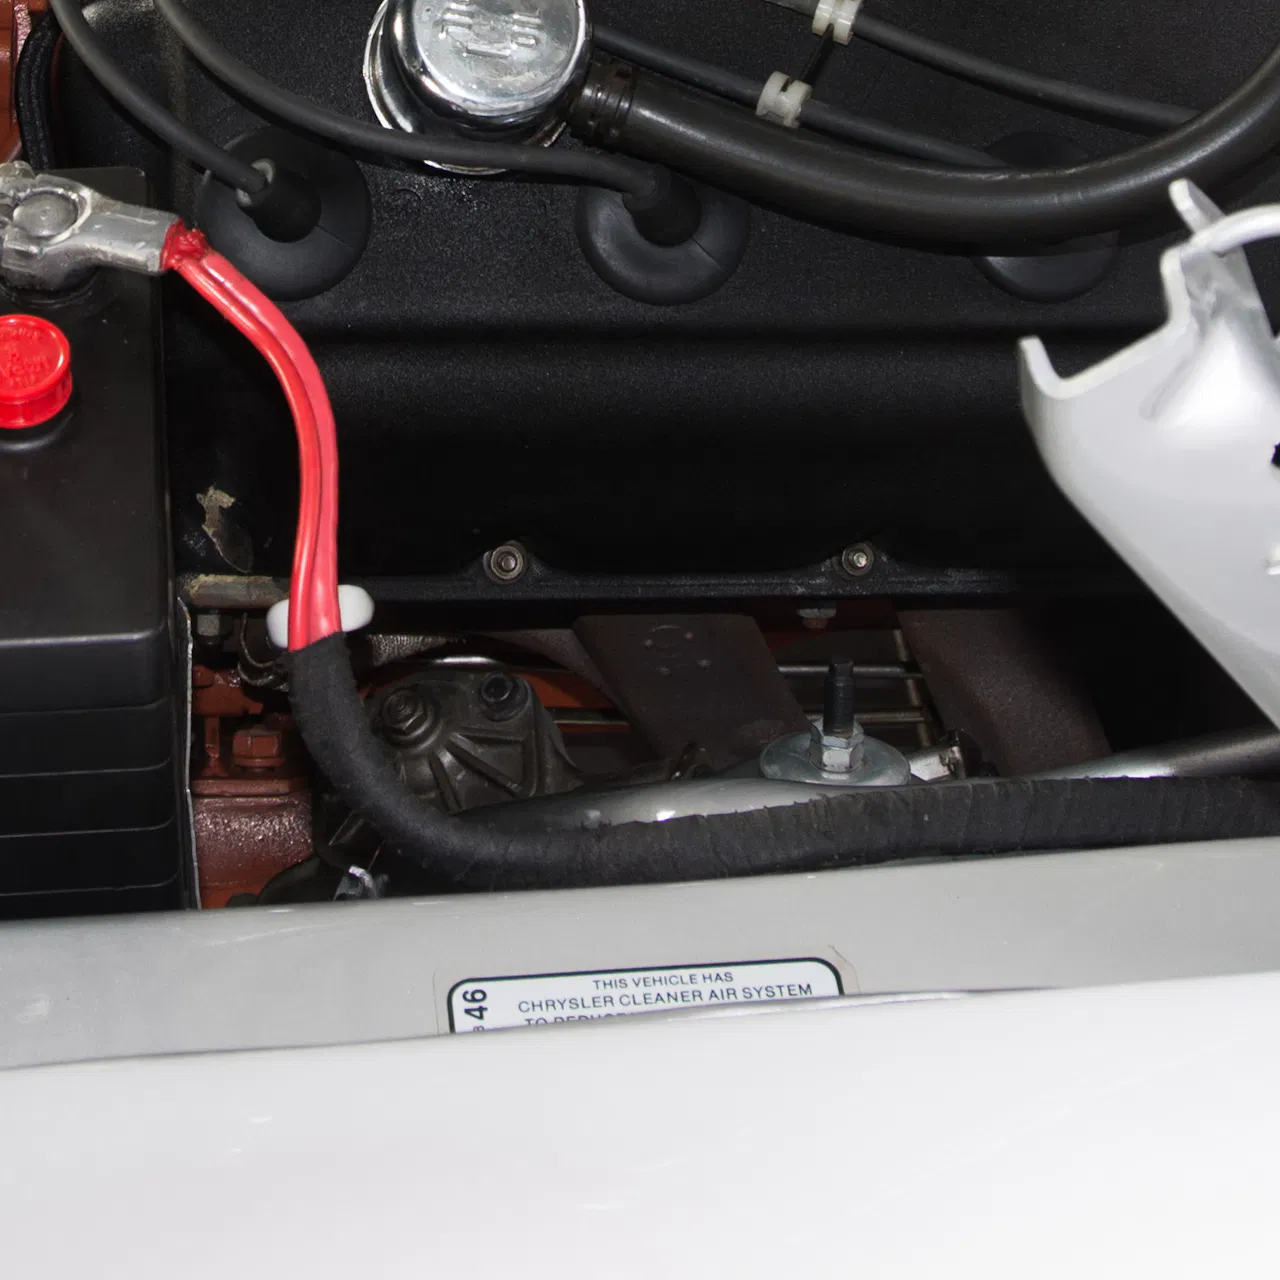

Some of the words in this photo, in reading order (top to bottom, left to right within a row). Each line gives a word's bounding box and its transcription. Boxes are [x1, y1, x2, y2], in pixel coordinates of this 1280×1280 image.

[592, 978, 628, 991] THIS
[632, 974, 698, 988] VEHICLE
[703, 971, 734, 984] HAS
[462, 988, 488, 1020] 46
[517, 993, 615, 1013] CHRYSLER
[619, 988, 704, 1007] CLEANER
[708, 986, 738, 1001] AIR
[742, 983, 813, 1000] SYSTEM
